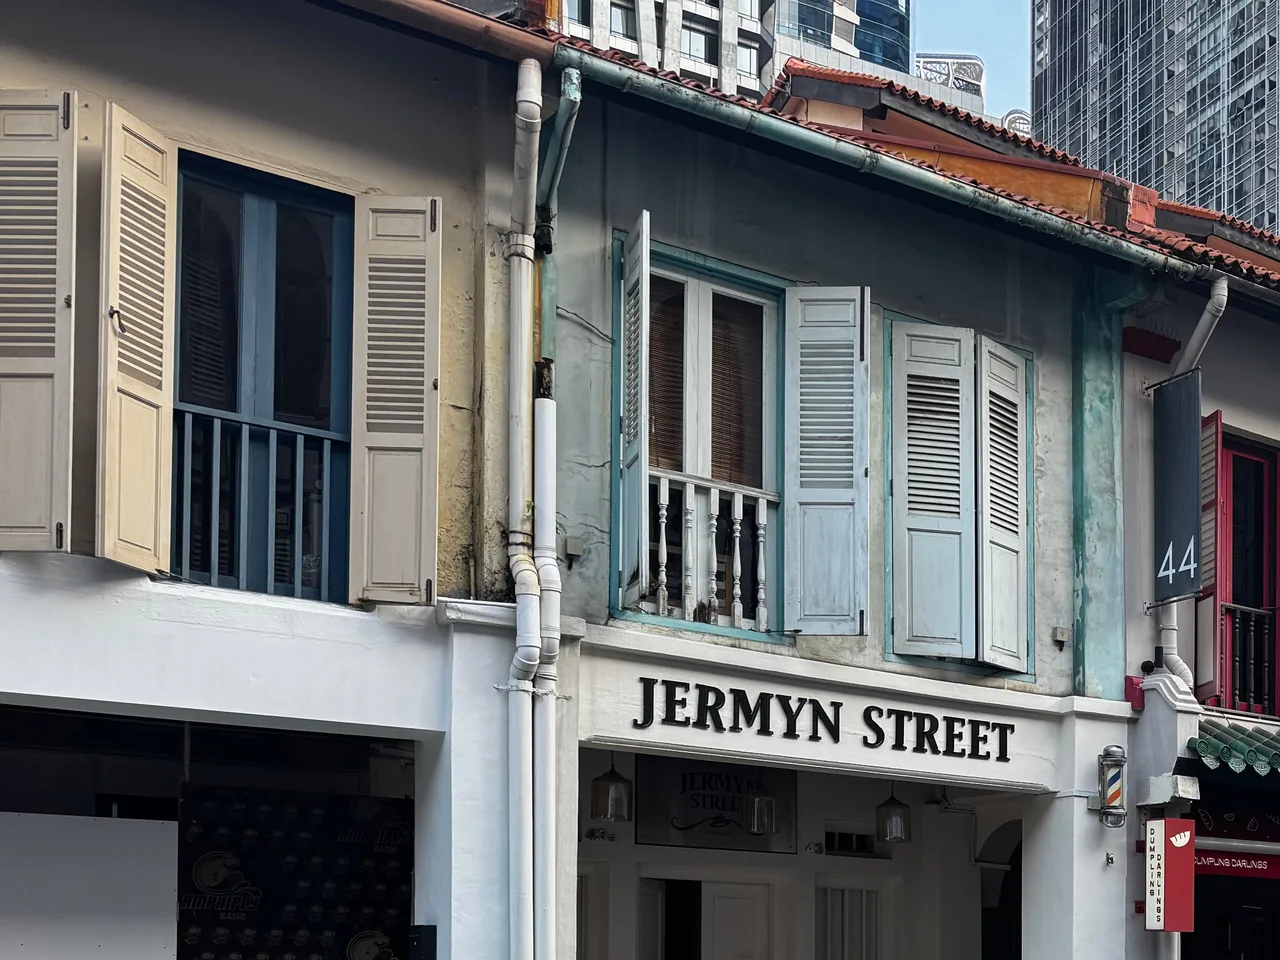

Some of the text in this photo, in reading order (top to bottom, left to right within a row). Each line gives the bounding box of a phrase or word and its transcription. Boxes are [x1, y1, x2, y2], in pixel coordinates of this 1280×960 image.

[1157, 534, 1198, 584] 44
[631, 675, 1016, 763] JERMYN STREET
[691, 793, 745, 811] STREE
[1231, 858, 1268, 869] DARLINGS
[219, 912, 247, 921] BASIC
